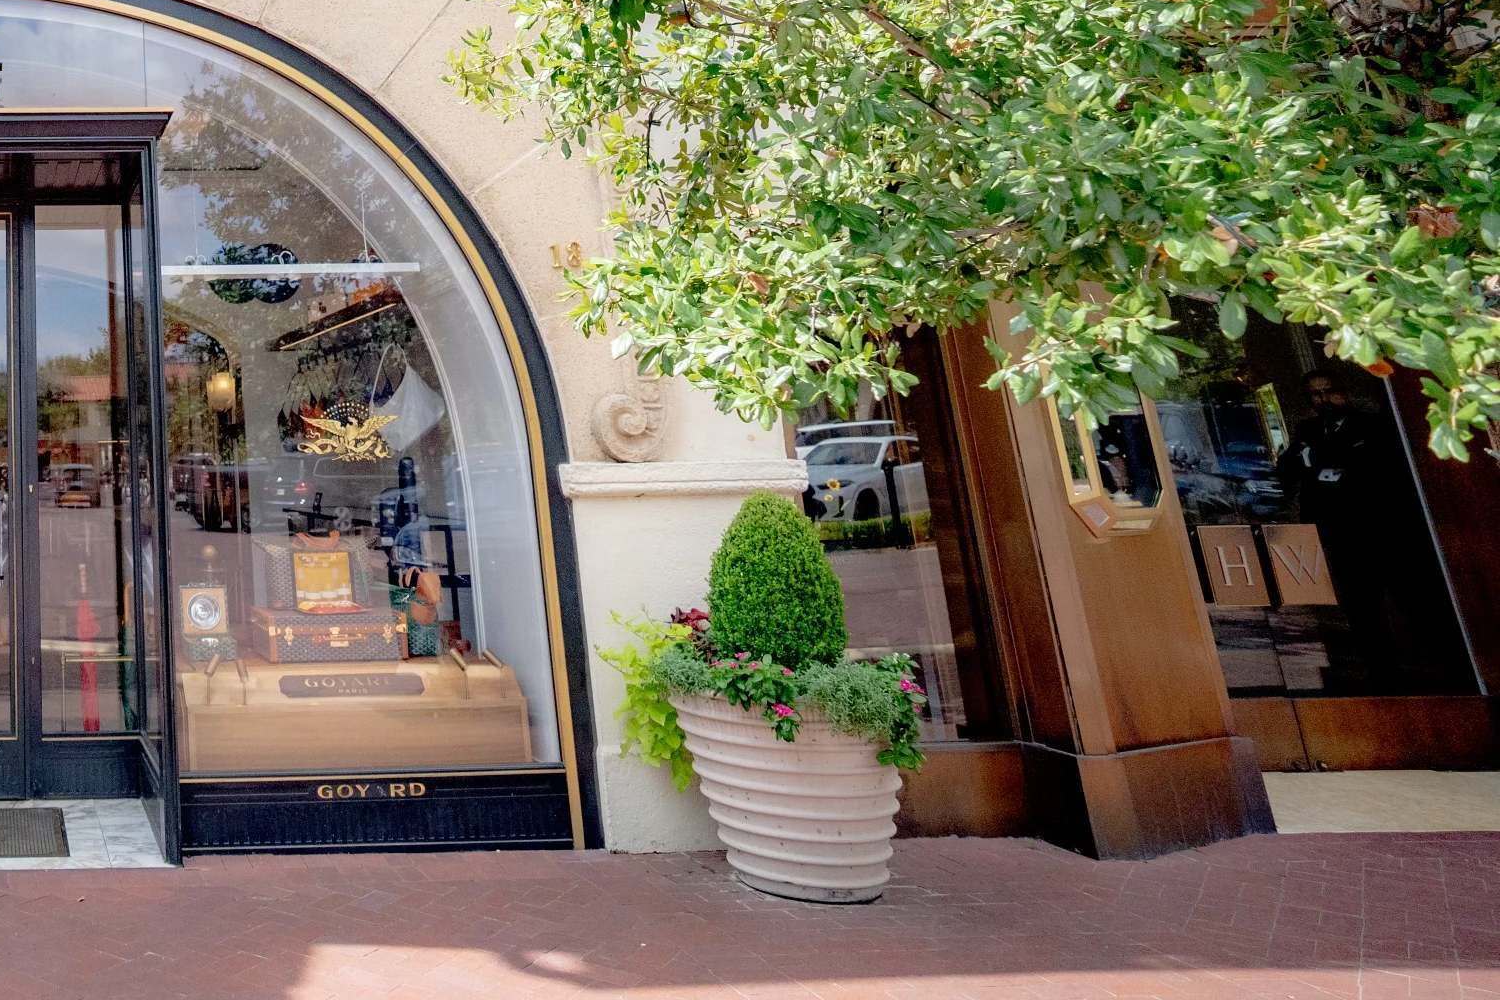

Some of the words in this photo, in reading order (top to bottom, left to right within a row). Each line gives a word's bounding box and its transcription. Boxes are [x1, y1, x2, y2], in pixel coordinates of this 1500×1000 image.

[550, 242, 582, 268] 18
[338, 687, 369, 695] PARIS
[317, 782, 426, 799] GOYRD
